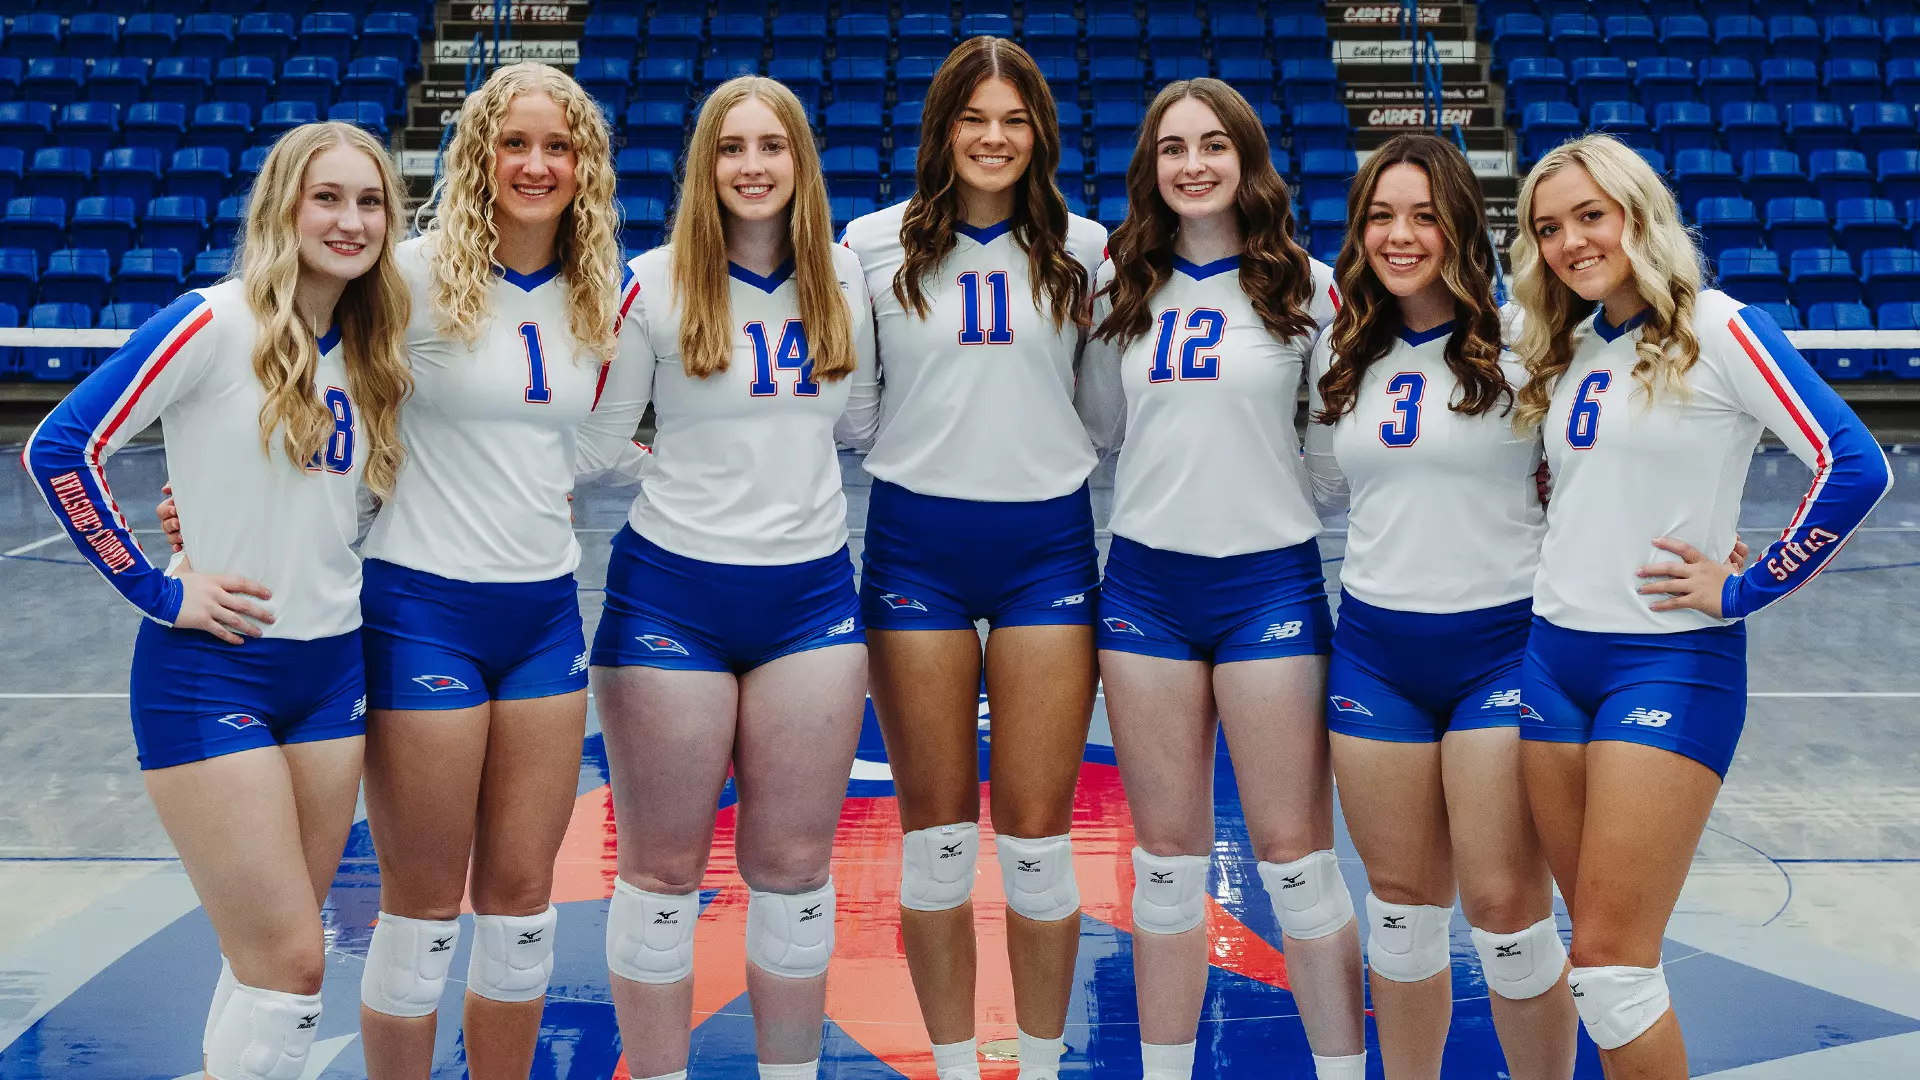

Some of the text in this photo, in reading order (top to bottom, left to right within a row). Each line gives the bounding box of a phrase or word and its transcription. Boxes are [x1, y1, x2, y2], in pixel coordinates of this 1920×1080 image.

[471, 4, 529, 20] CAET
[1368, 109, 1426, 125] CARPET
[957, 271, 1014, 345] 11
[1148, 307, 1228, 384] 12
[518, 321, 552, 404] 1
[743, 318, 820, 397] 14
[303, 385, 356, 476] 8
[1378, 371, 1427, 448] 3
[1565, 370, 1612, 450] 6
[49, 471, 136, 575] LUBBOCK CHRISTIAN
[1620, 707, 1672, 728] NB
